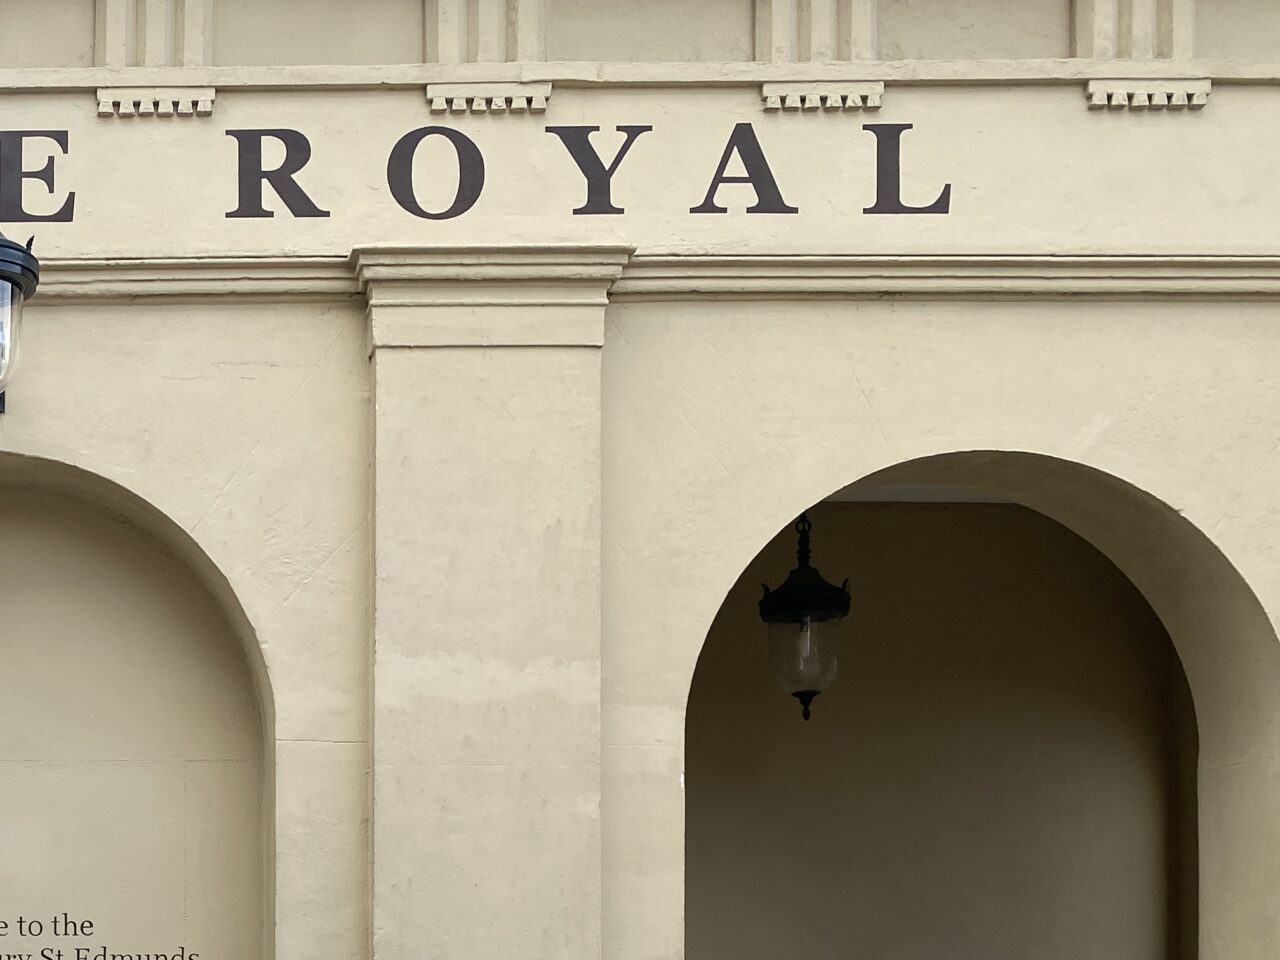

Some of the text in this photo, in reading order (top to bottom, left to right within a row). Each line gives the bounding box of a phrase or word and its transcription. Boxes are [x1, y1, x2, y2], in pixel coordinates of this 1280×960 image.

[225, 122, 951, 220] ROYAL
[17, 916, 44, 938] to
[51, 912, 95, 938] the
